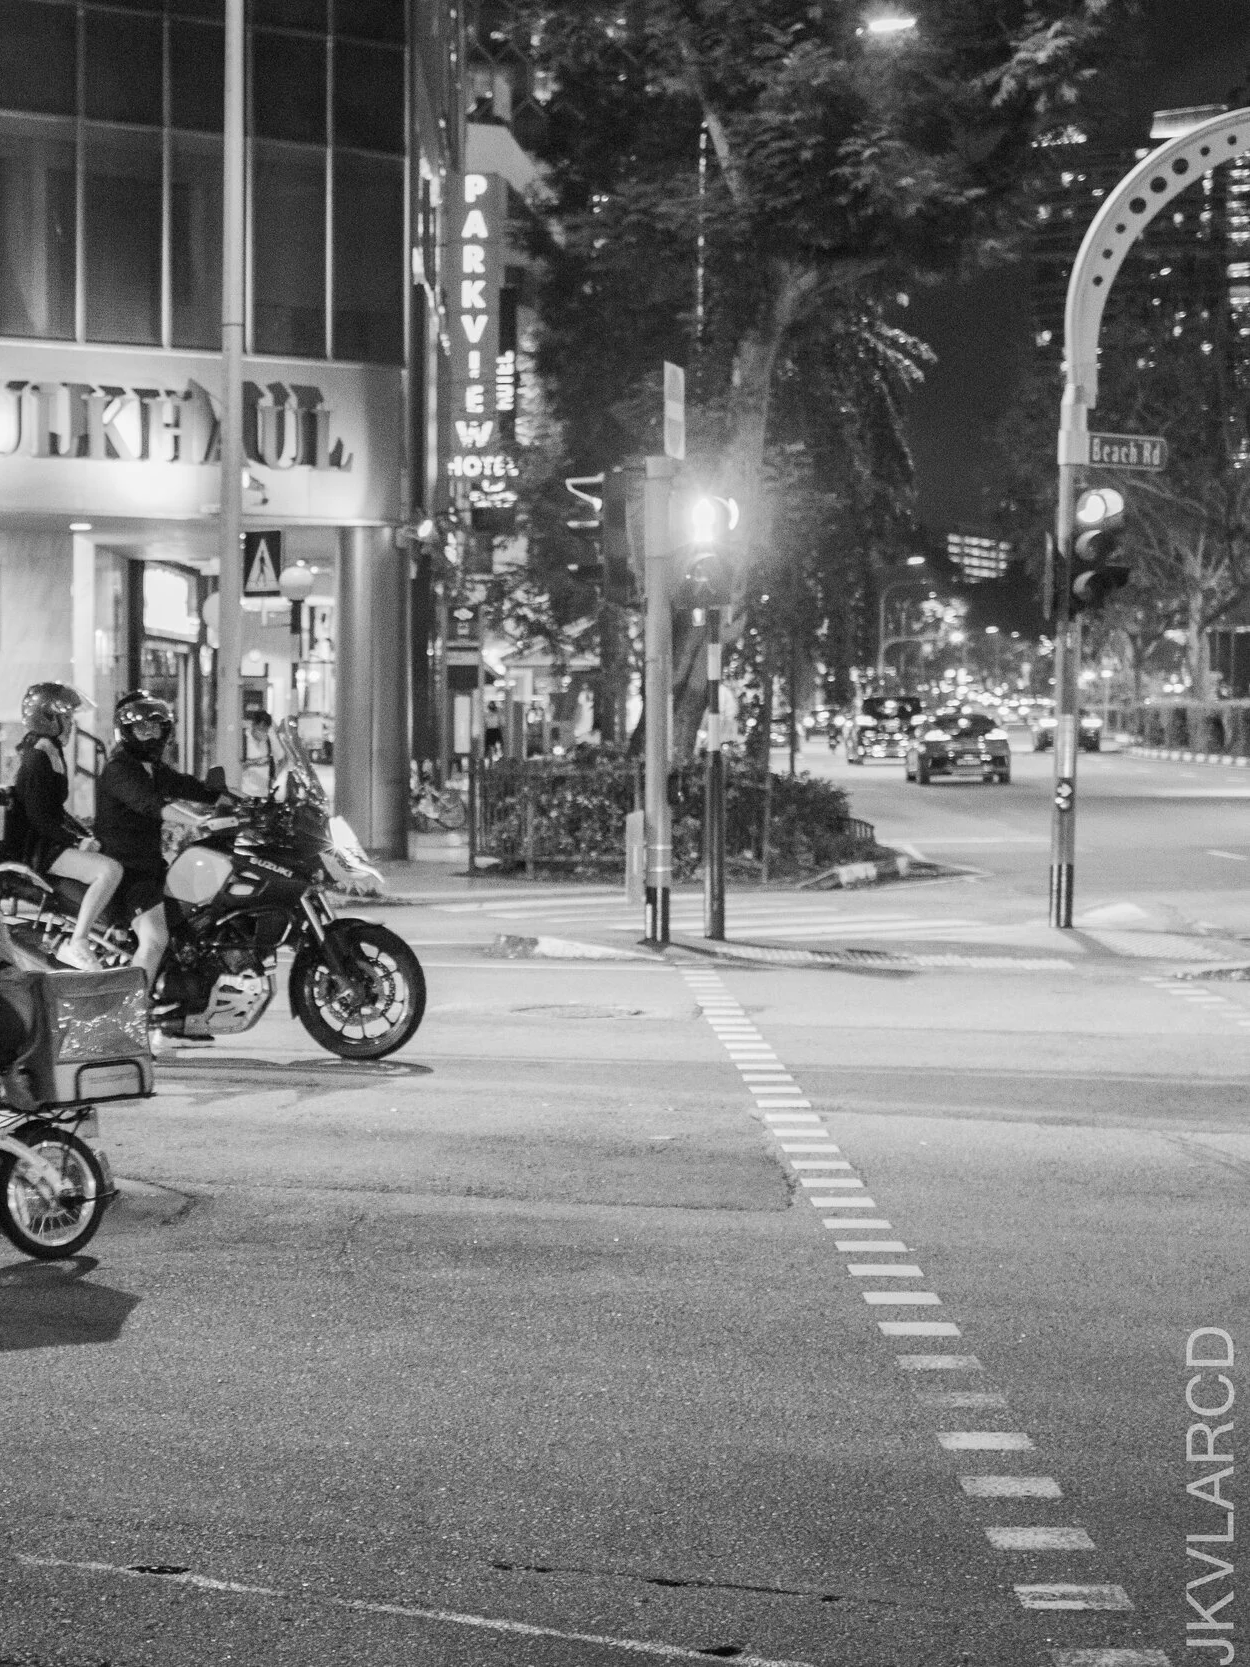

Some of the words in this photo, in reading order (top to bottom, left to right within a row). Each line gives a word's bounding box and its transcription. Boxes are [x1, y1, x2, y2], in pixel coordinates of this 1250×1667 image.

[456, 173, 493, 448] PARKVIEW
[1092, 437, 1138, 464] Beach
[1143, 440, 1161, 466] Rd
[250, 857, 293, 879] SUZUKI
